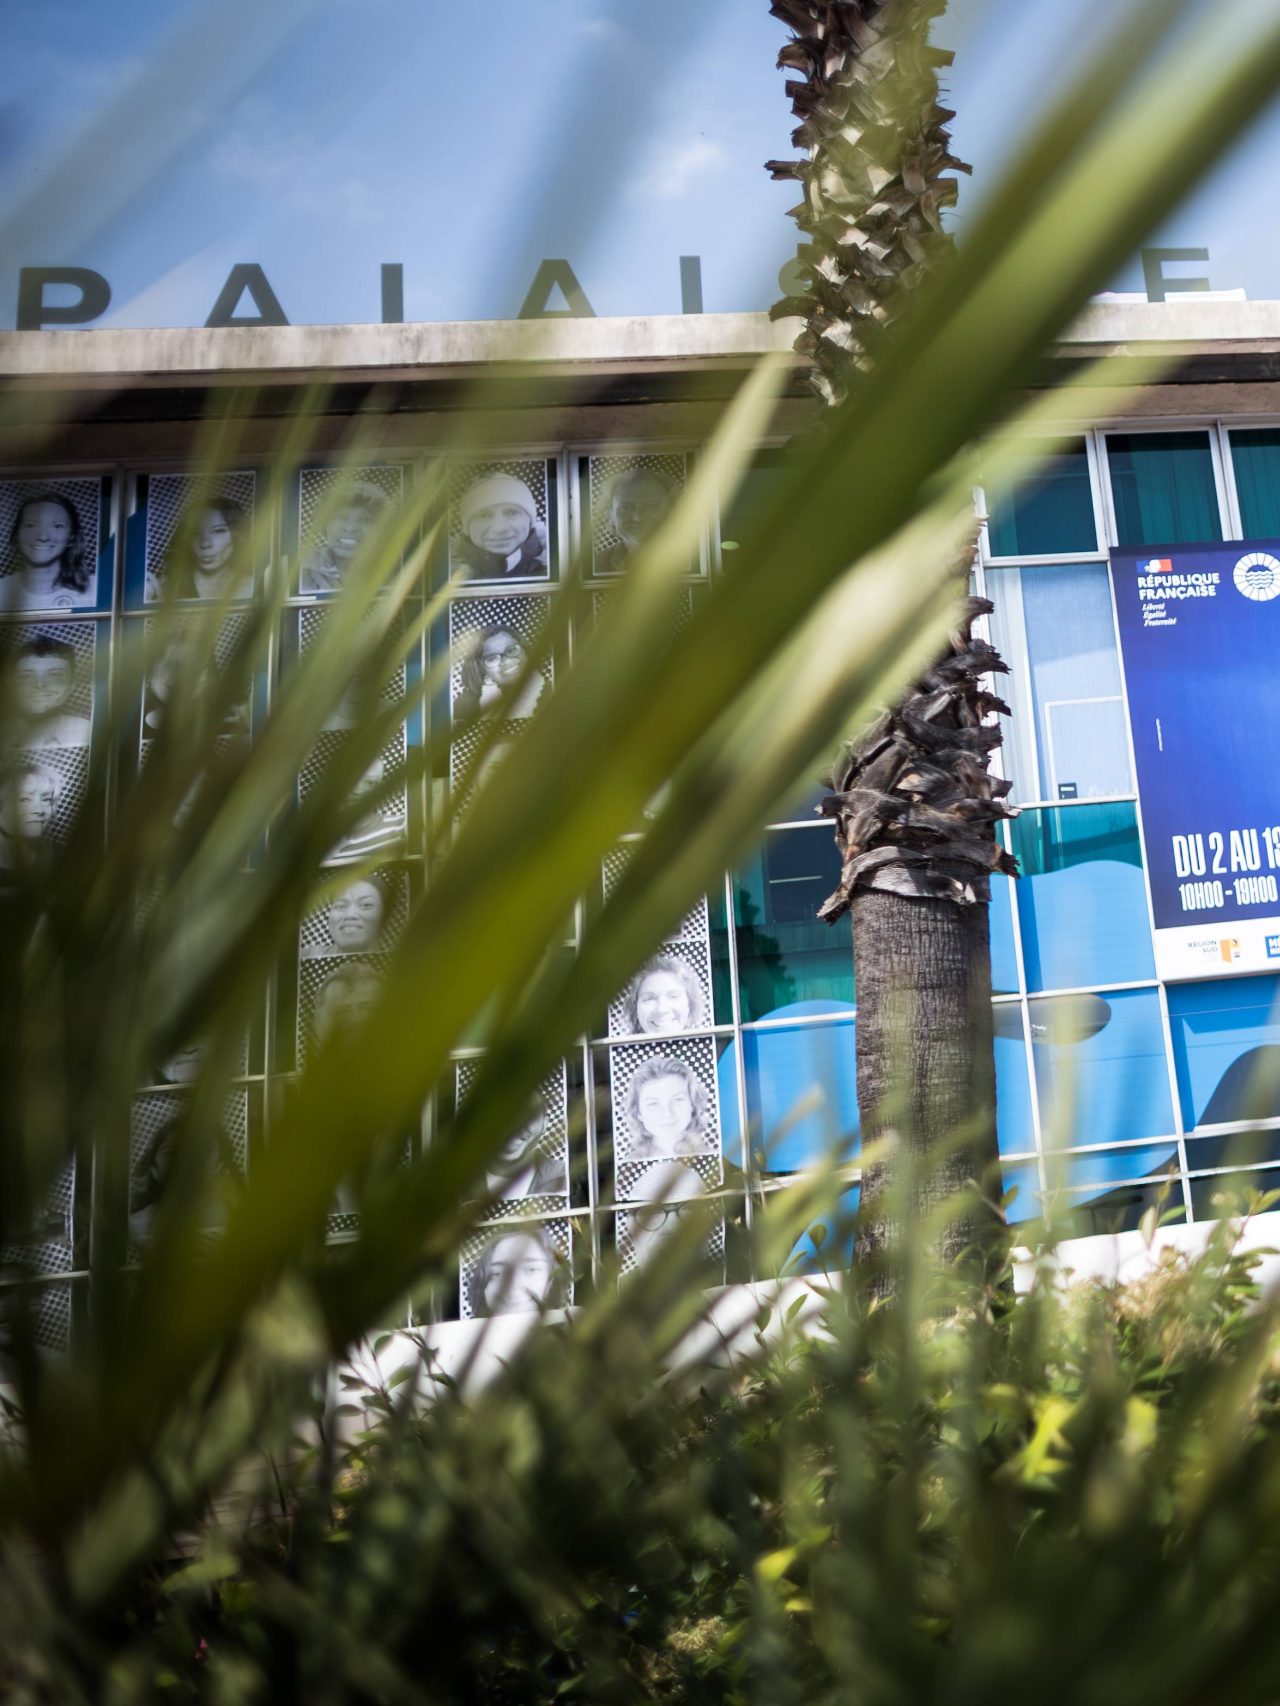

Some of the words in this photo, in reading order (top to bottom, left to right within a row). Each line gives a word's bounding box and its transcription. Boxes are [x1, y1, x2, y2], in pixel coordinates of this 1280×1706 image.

[1137, 573, 1221, 588] RÉPUBLIQUE
[1139, 585, 1217, 600] FRANÇAISE
[1172, 833, 1206, 878] DU
[1209, 831, 1227, 875] 2
[1229, 828, 1261, 873] AU
[1178, 880, 1225, 911] 10H00
[1233, 875, 1279, 906] 19H00
